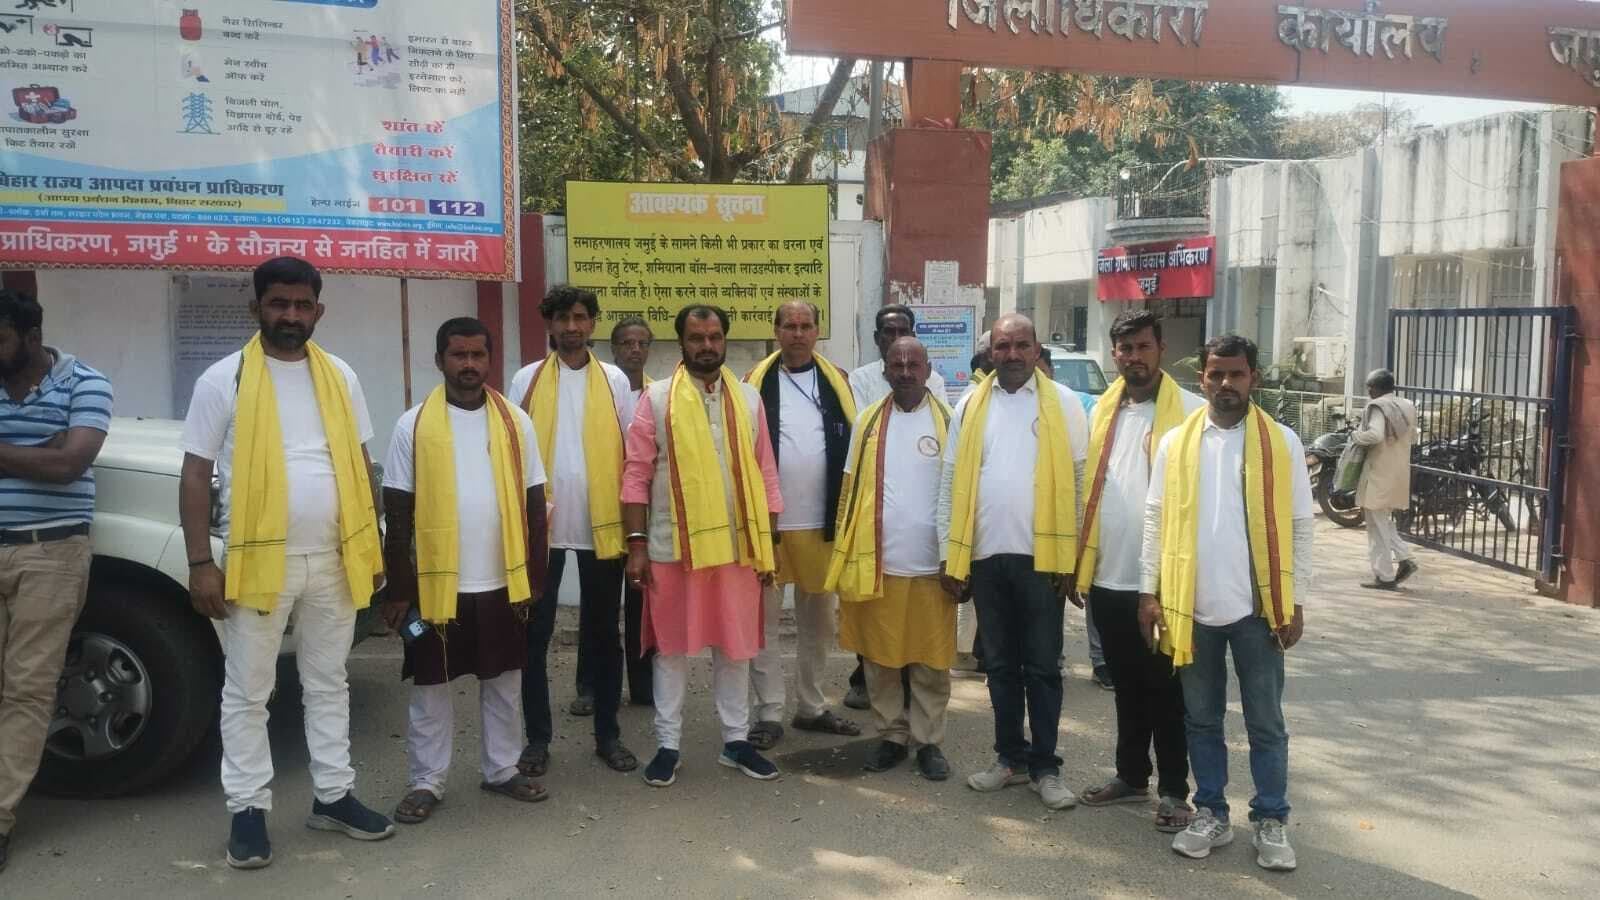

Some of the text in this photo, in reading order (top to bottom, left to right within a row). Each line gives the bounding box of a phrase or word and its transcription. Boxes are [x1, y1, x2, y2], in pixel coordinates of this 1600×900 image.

[382, 117, 445, 134] शांत रहें
[375, 143, 454, 158] तैयारी करें
[0, 170, 284, 196] बिहार राज्य आपदा प्रबंधन प्राधिकरण
[372, 168, 459, 184] सुरक्षित रहें
[310, 196, 331, 208] हेल्प
[378, 199, 417, 212] 101
[437, 201, 477, 216] 112
[630, 192, 766, 223] आवश्यक सूचना
[0, 226, 118, 257] प्राधिकरण,
[126, 229, 179, 261] जमुई
[205, 230, 231, 255] के
[236, 230, 308, 258] सौजन्य
[313, 235, 334, 258] से
[339, 236, 409, 260] जनहित
[414, 238, 432, 260] में
[436, 239, 479, 263] जारी
[573, 232, 824, 255] समाहरणालय जमुई के सामने किसी भी प्रकार का धरना एवं
[574, 256, 603, 273] प्रदर्शन
[606, 257, 620, 279] हेतु
[740, 258, 791, 275] लाउडस्पीकर
[1097, 251, 1114, 273] जिला
[1139, 248, 1166, 270] विकास
[1168, 242, 1211, 267] अभिकरण
[611, 281, 637, 298] वर्जित
[653, 282, 672, 301] ऐसा
[675, 282, 697, 298] करने
[699, 283, 718, 298] वाले
[721, 281, 758, 298] व्यक्तियों
[760, 283, 774, 301] एवं
[777, 283, 811, 298] संस्थाओं
[813, 283, 822, 298] के
[1137, 273, 1160, 296] जमुई
[741, 305, 774, 324] कार्रवाई
